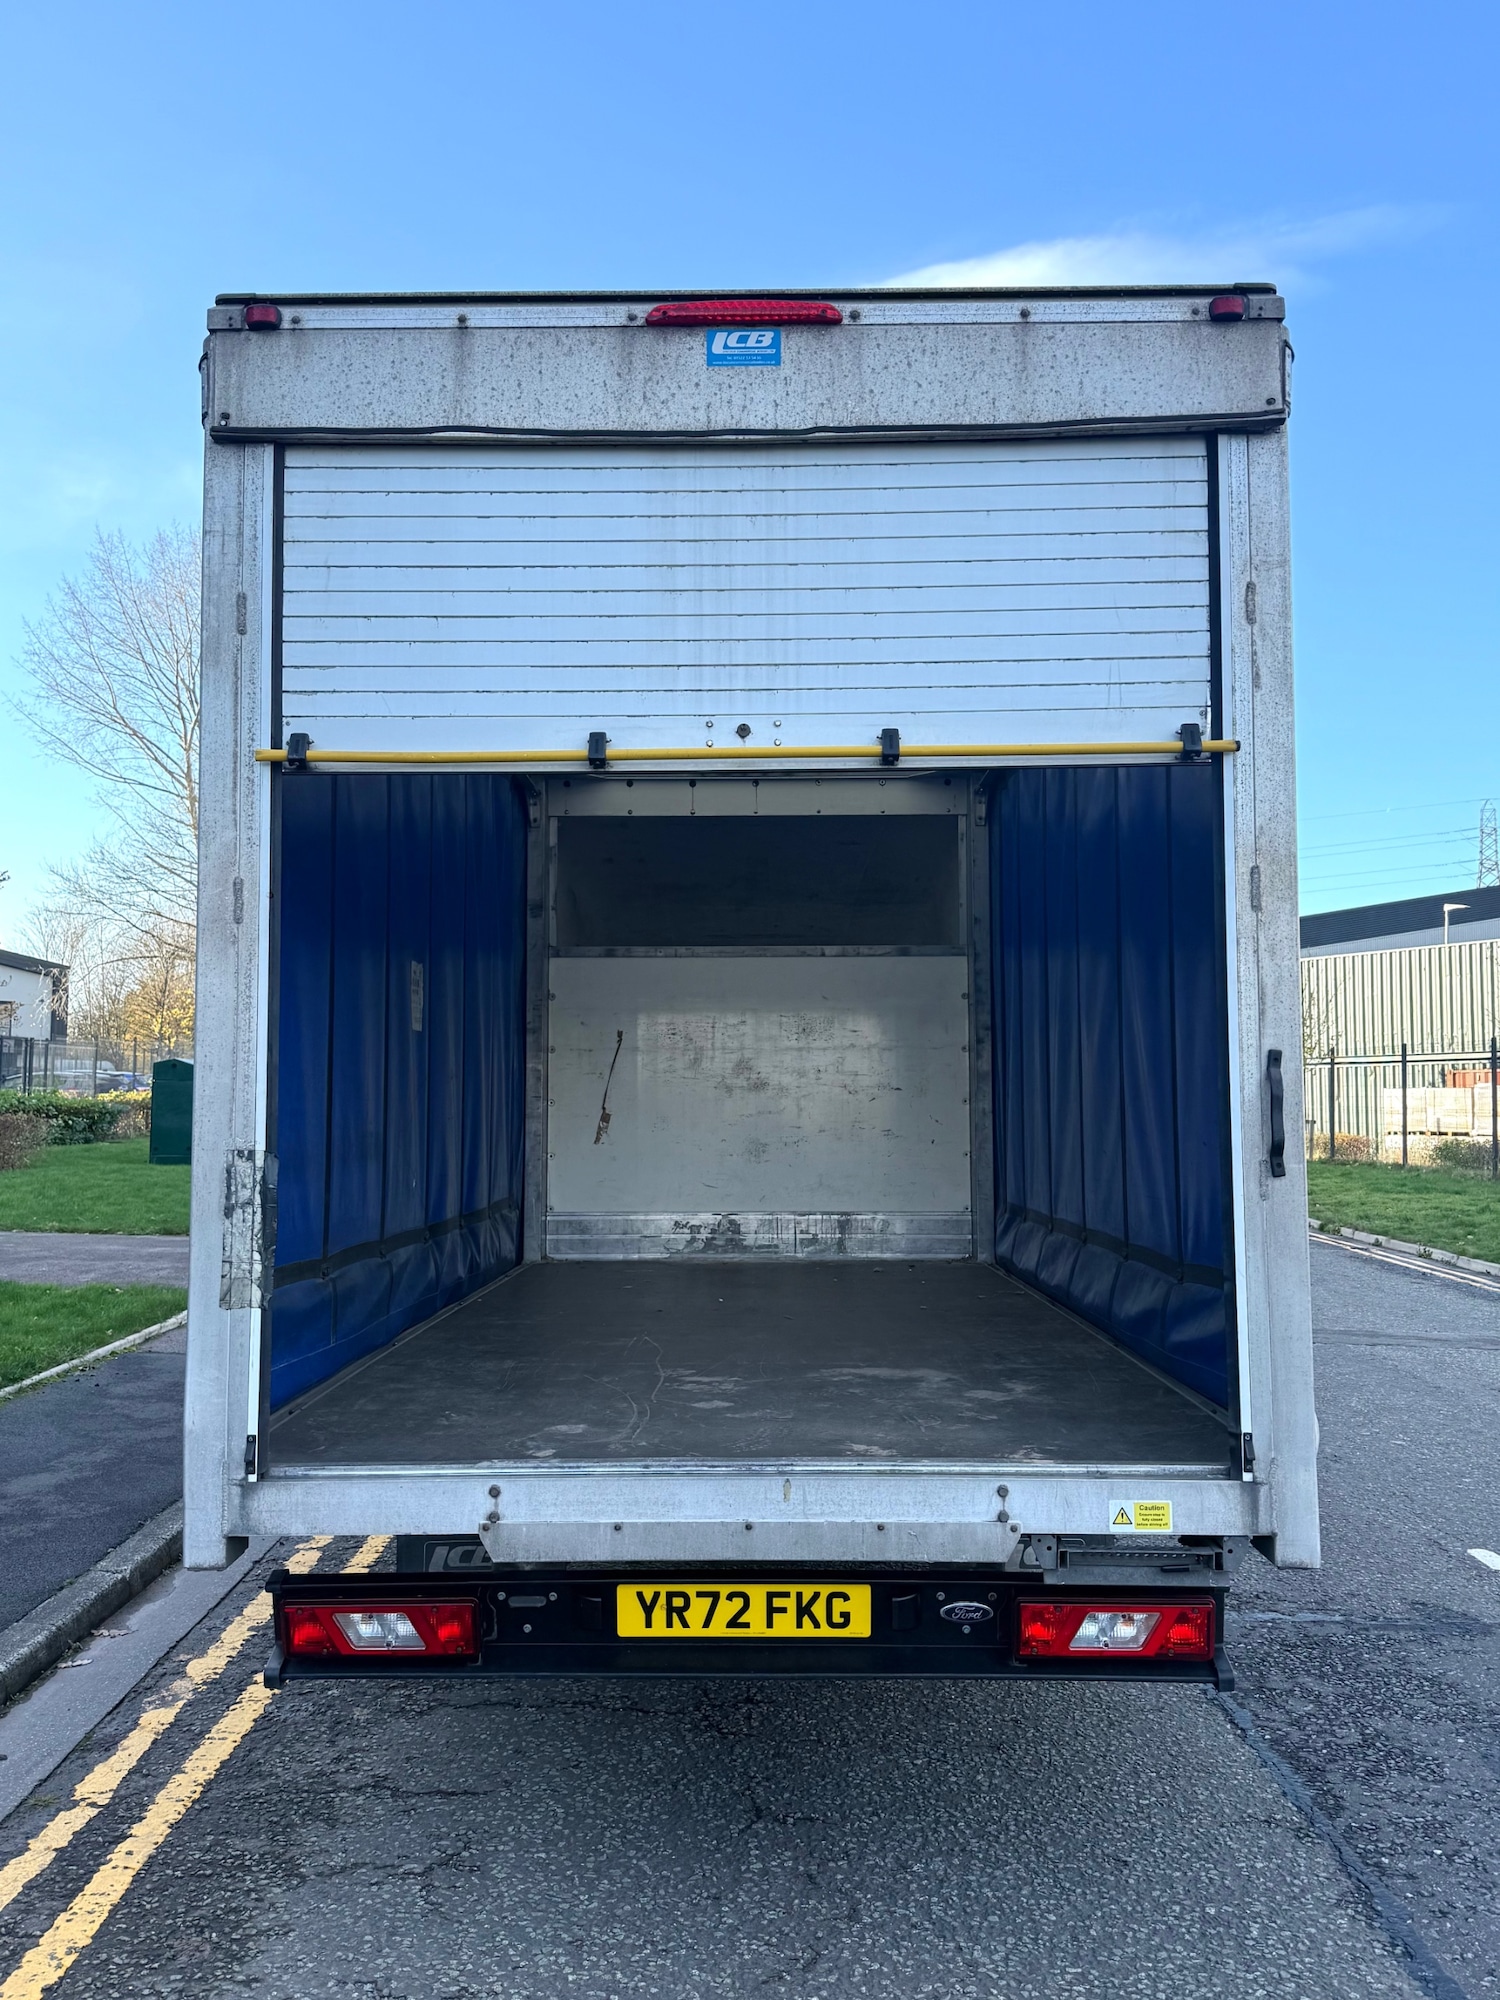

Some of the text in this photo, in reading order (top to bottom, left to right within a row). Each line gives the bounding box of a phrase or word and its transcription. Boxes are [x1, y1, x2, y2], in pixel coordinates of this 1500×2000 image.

[712, 332, 776, 354] LCB
[636, 1591, 851, 1629] YR72 FKG
[952, 1606, 983, 1619] Ford
